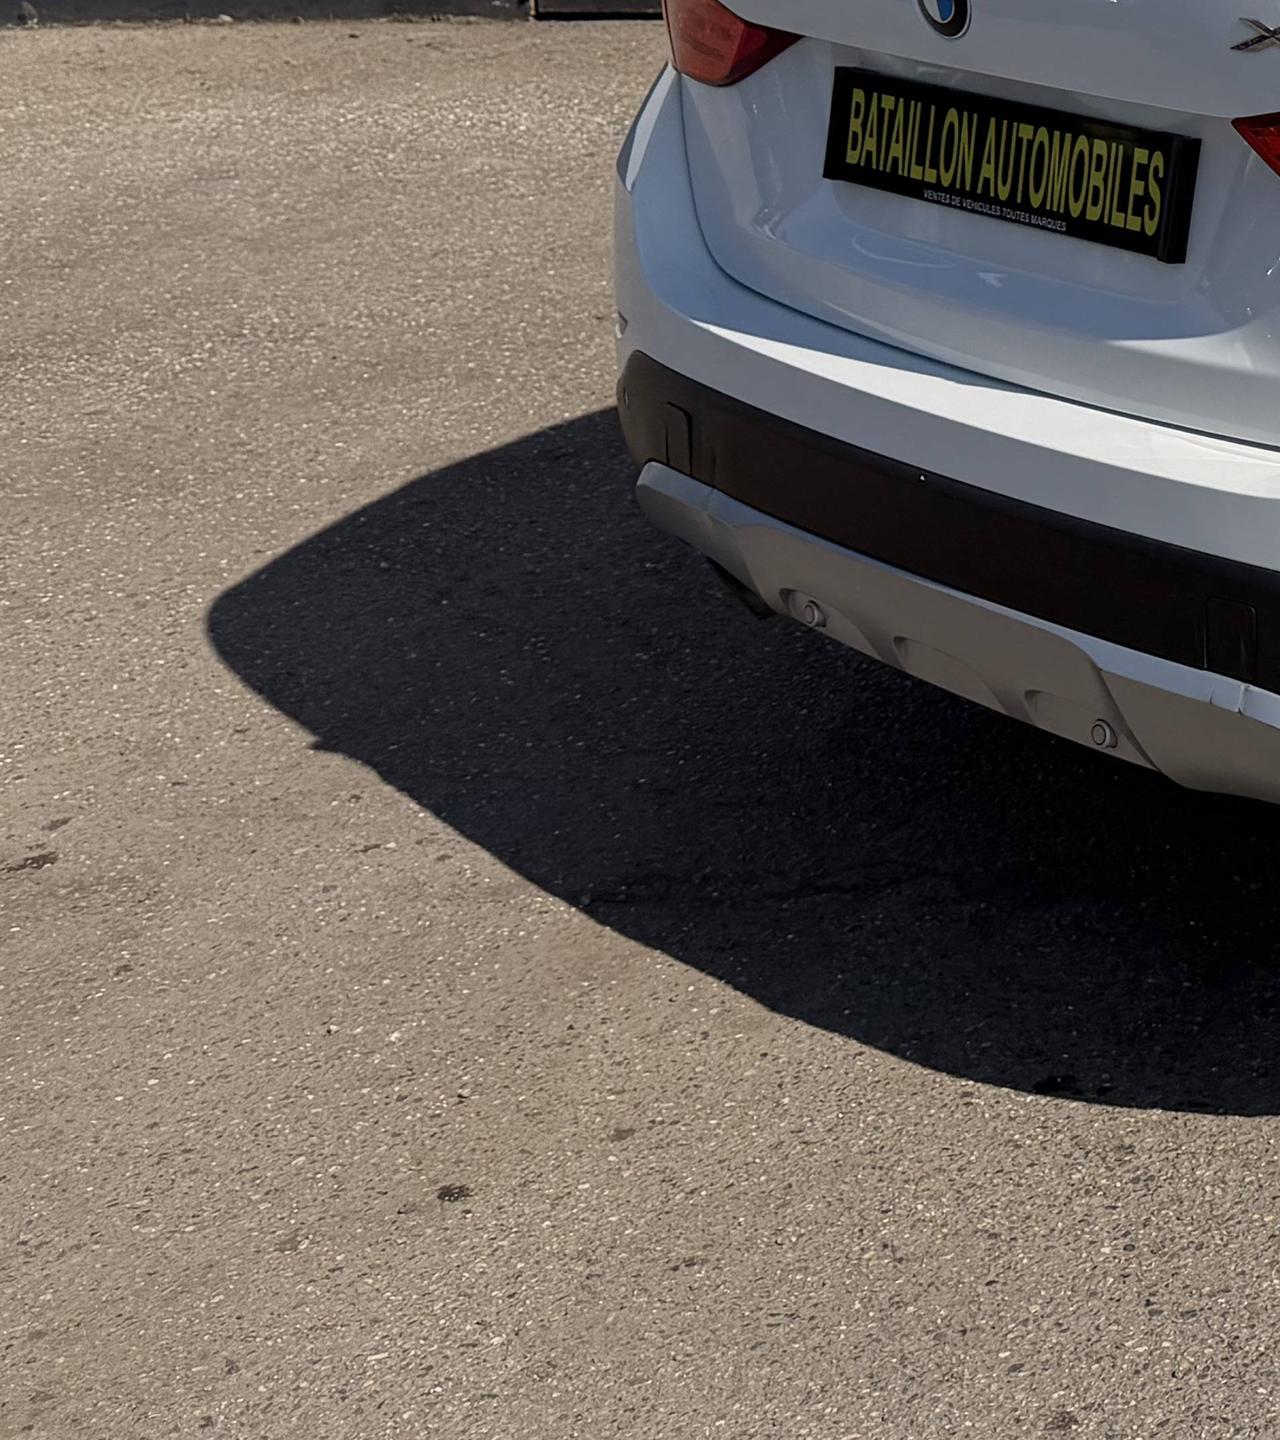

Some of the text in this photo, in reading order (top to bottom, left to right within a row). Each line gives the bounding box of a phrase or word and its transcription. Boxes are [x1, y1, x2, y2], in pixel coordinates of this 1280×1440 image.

[845, 87, 1165, 236] BATAILLON AUTOMOBILES
[923, 189, 950, 203] VENTES
[951, 195, 961, 207] DE
[1002, 207, 1030, 222] TOUTES
[1030, 214, 1067, 231] MARQUES
